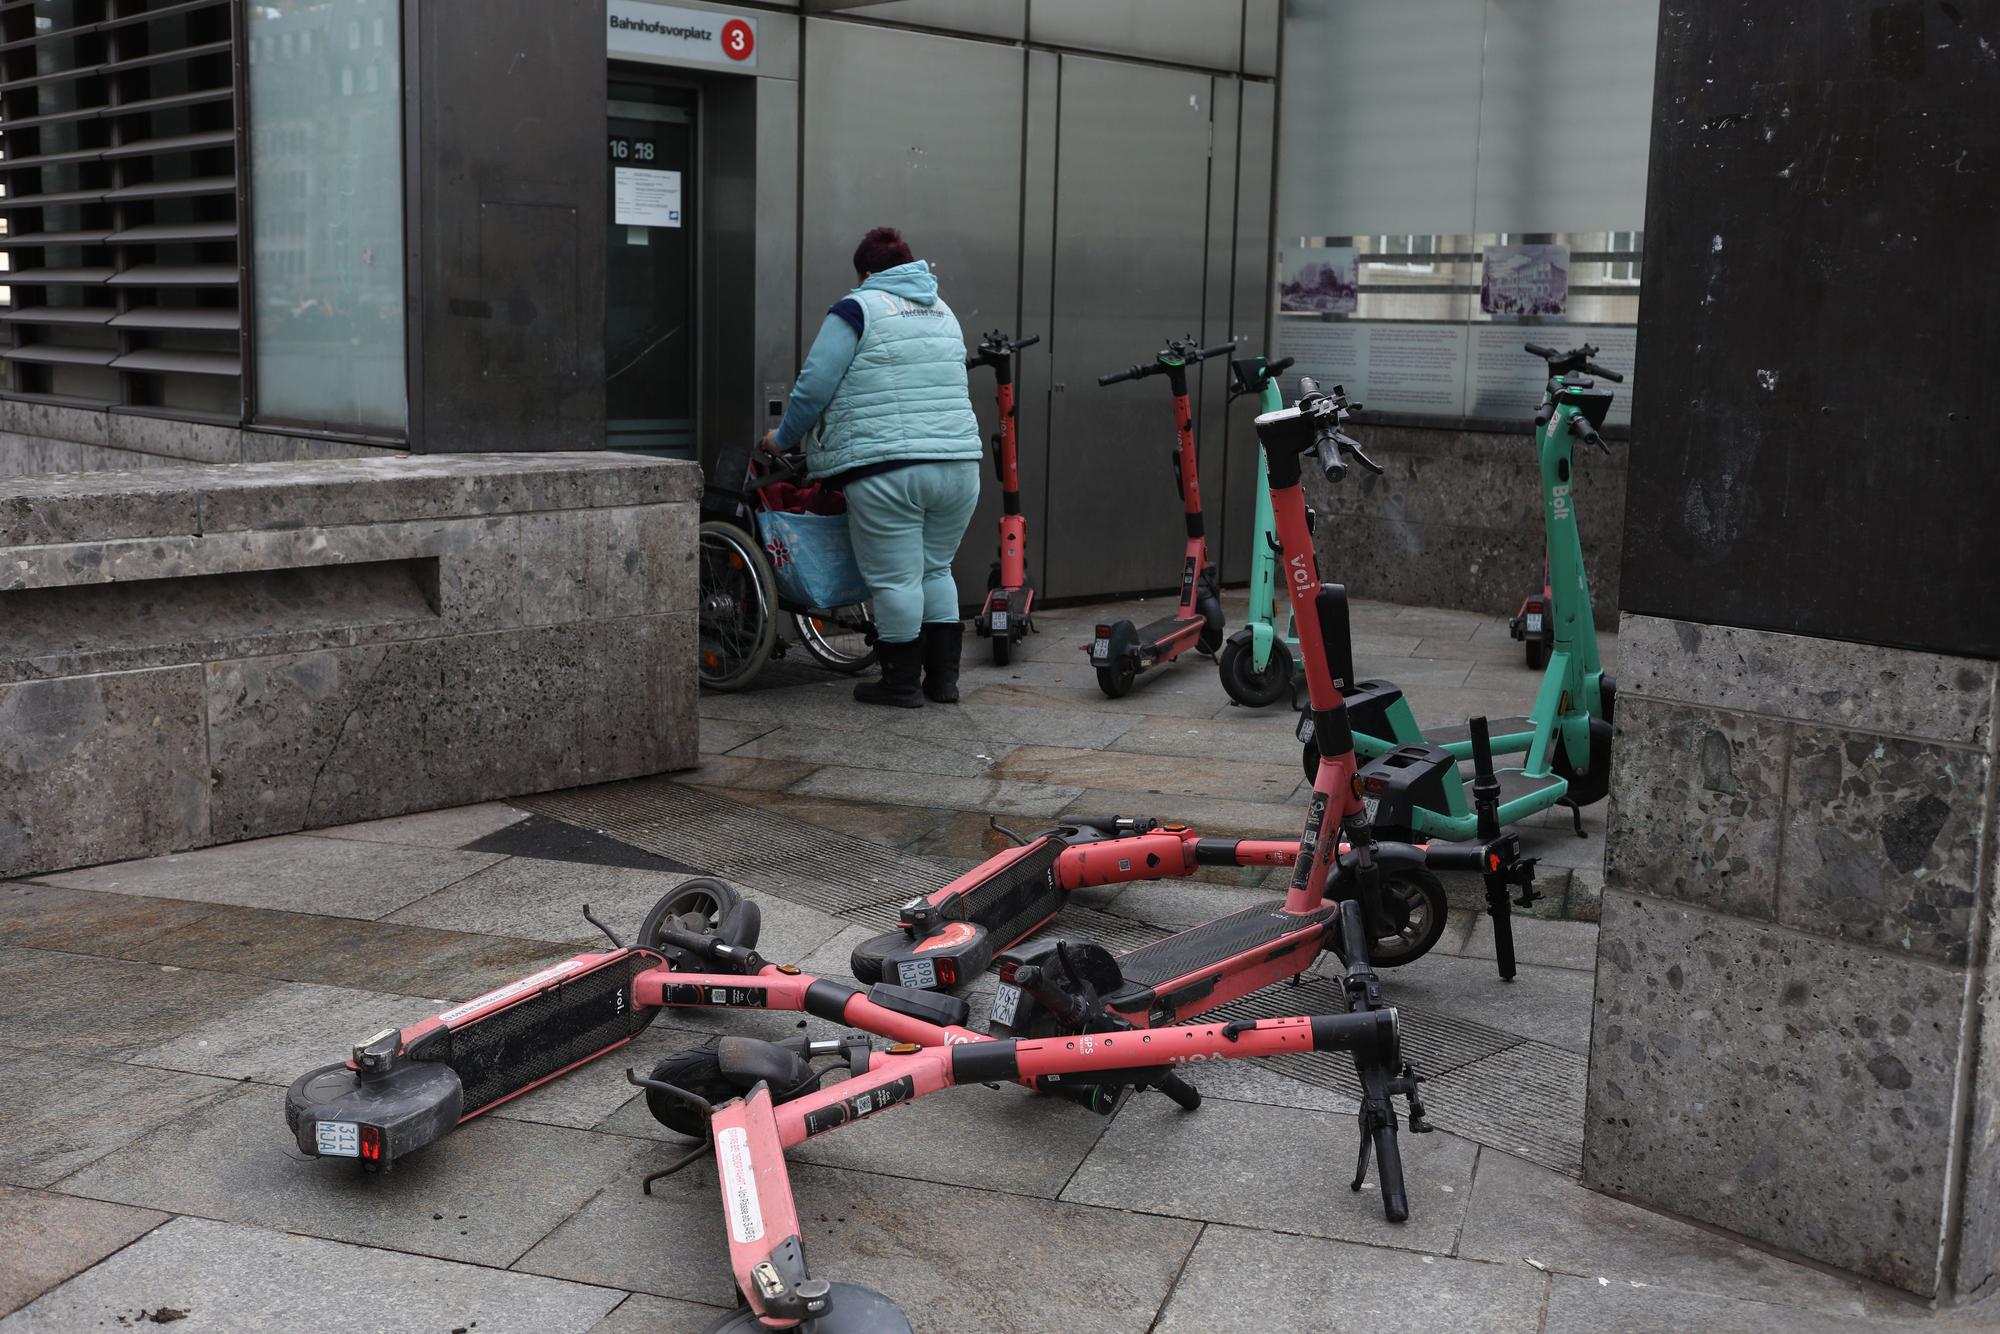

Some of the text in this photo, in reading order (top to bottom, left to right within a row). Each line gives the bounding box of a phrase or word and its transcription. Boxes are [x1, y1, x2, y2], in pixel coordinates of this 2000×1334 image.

[610, 15, 745, 51] Bahnhofsvorplatz 3
[609, 140, 628, 158] 16
[1551, 485, 1569, 520] Bolt
[901, 963, 917, 988] MJG
[917, 962, 933, 984] 898
[320, 1123, 336, 1150] MJA
[339, 1126, 355, 1151] 311
